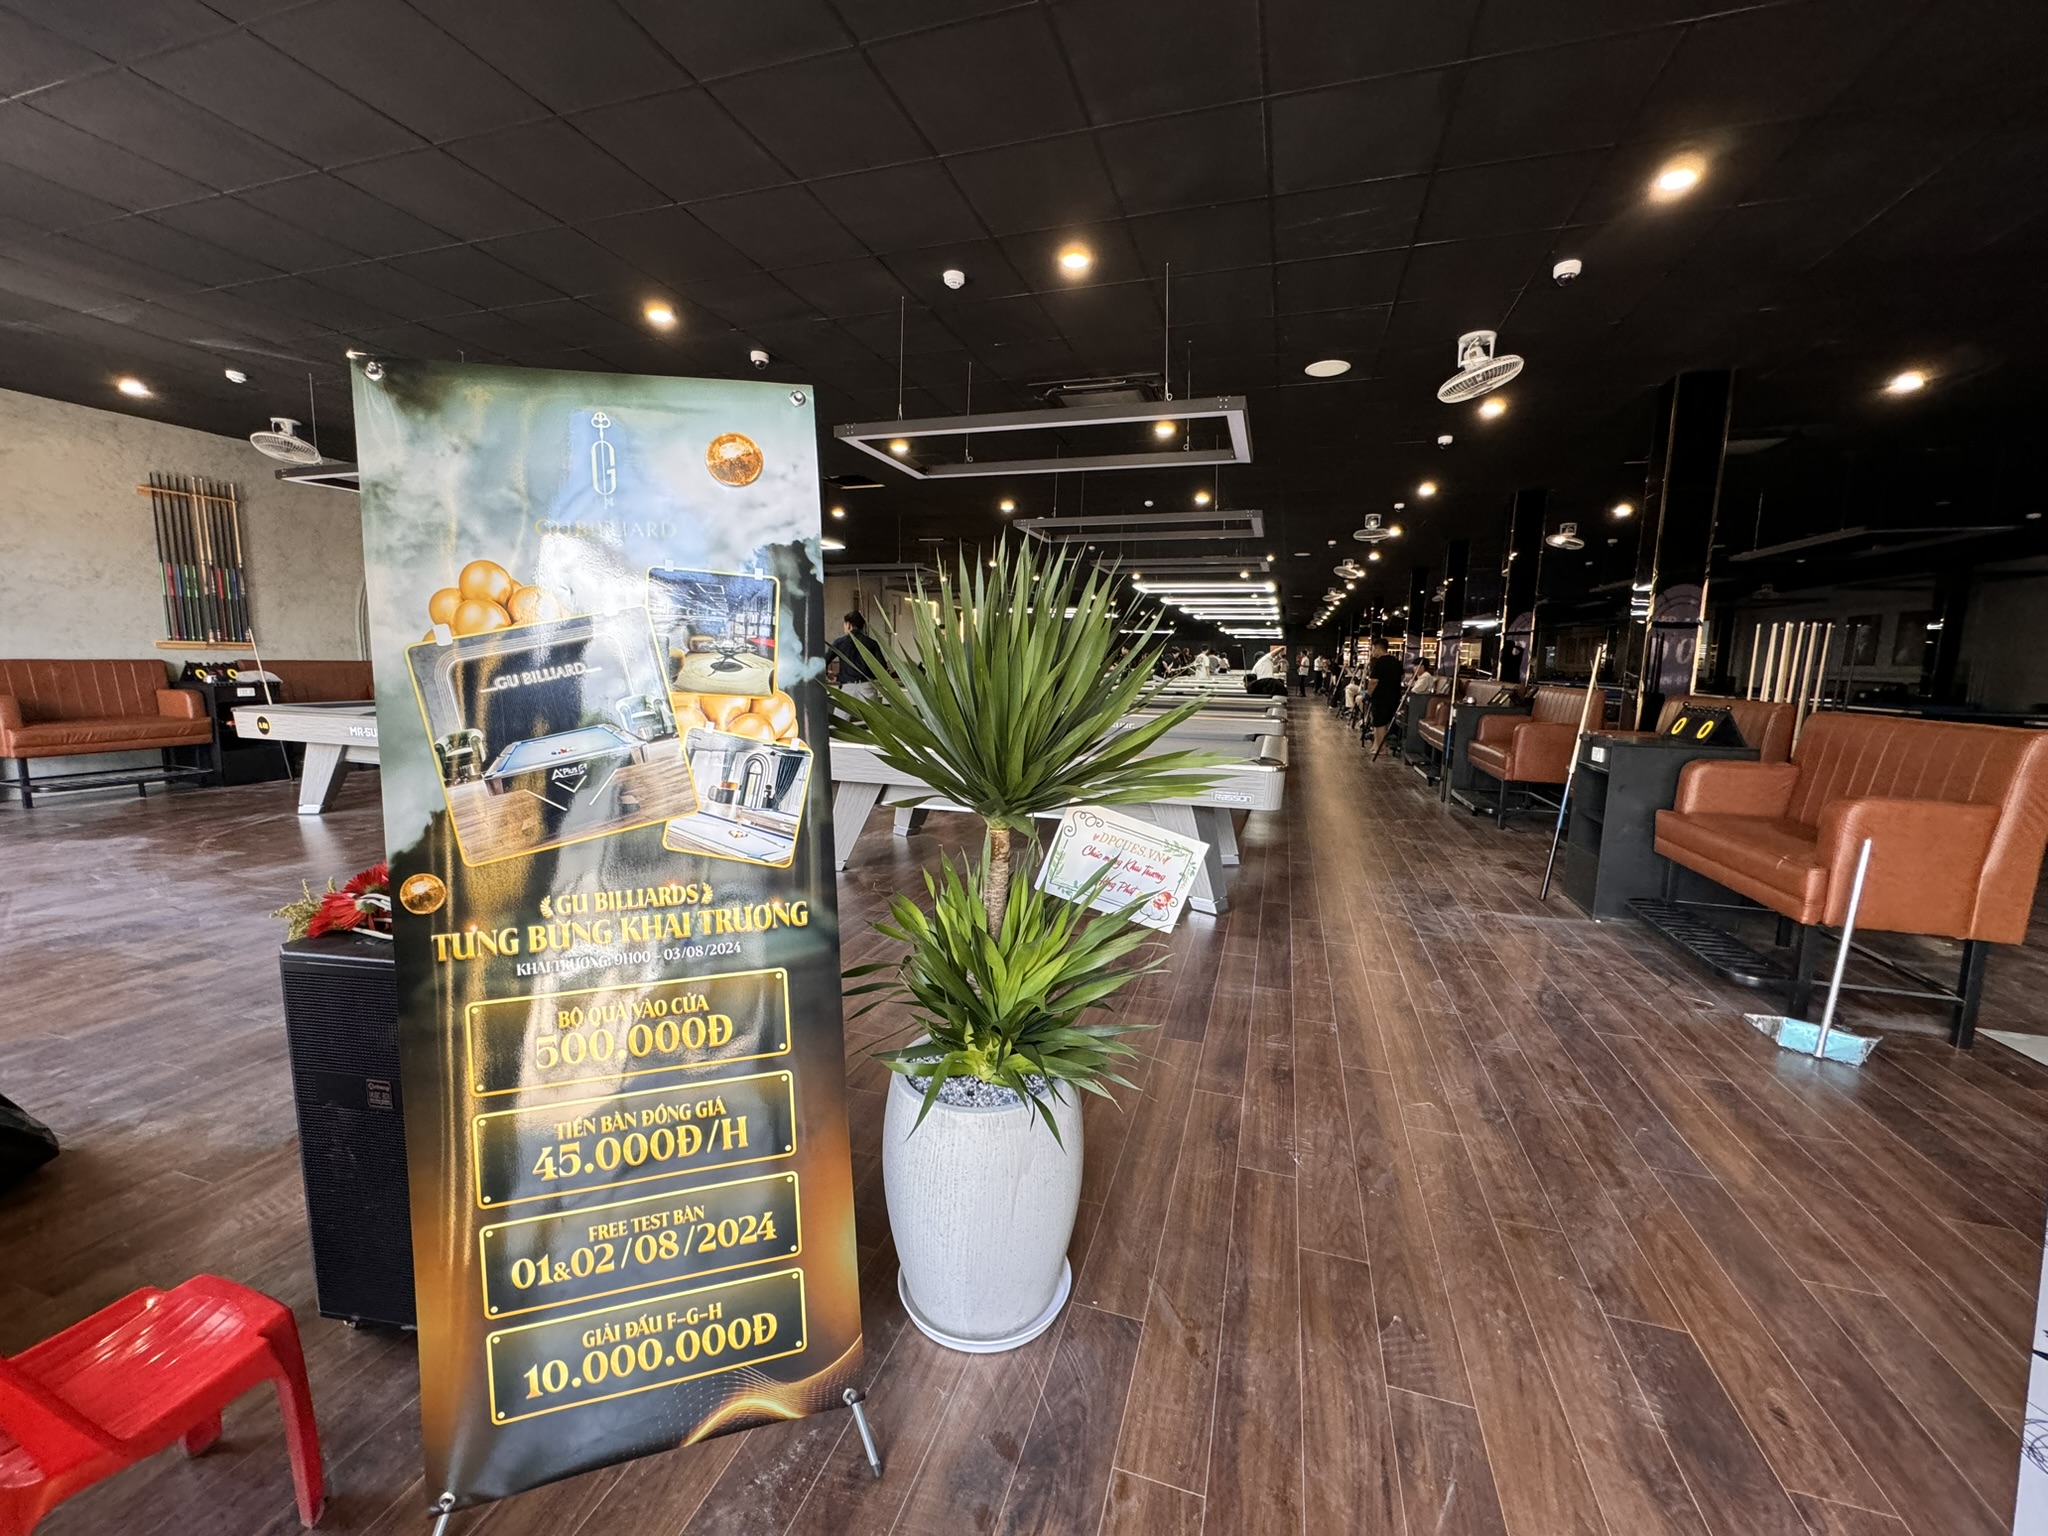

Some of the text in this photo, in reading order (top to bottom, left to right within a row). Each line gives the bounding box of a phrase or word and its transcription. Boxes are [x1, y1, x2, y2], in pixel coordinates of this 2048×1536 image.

[494, 662, 587, 689] GU BILLIARD
[349, 726, 378, 738] MR-SU
[557, 883, 699, 915] GU BILLIARDS
[527, 917, 613, 954] BỪNG
[620, 911, 692, 944] KHAI
[697, 900, 809, 936] TRƯƠNG
[516, 961, 550, 977] KHAI
[614, 951, 651, 966] 9H00
[663, 941, 742, 961] 03/08/2024
[558, 1006, 584, 1029] BỘ
[630, 997, 668, 1020] VÀO
[671, 991, 710, 1015] CỬA
[535, 1013, 734, 1070] 500.000Đ
[601, 1111, 637, 1135] BÀN
[695, 1095, 727, 1119] GIÁ
[588, 1204, 706, 1242] FREE TEST BÀN
[582, 1323, 621, 1349] GIẢI
[624, 1313, 664, 1341] ĐẤU
[523, 1311, 779, 1400] 10.000.000Đ
